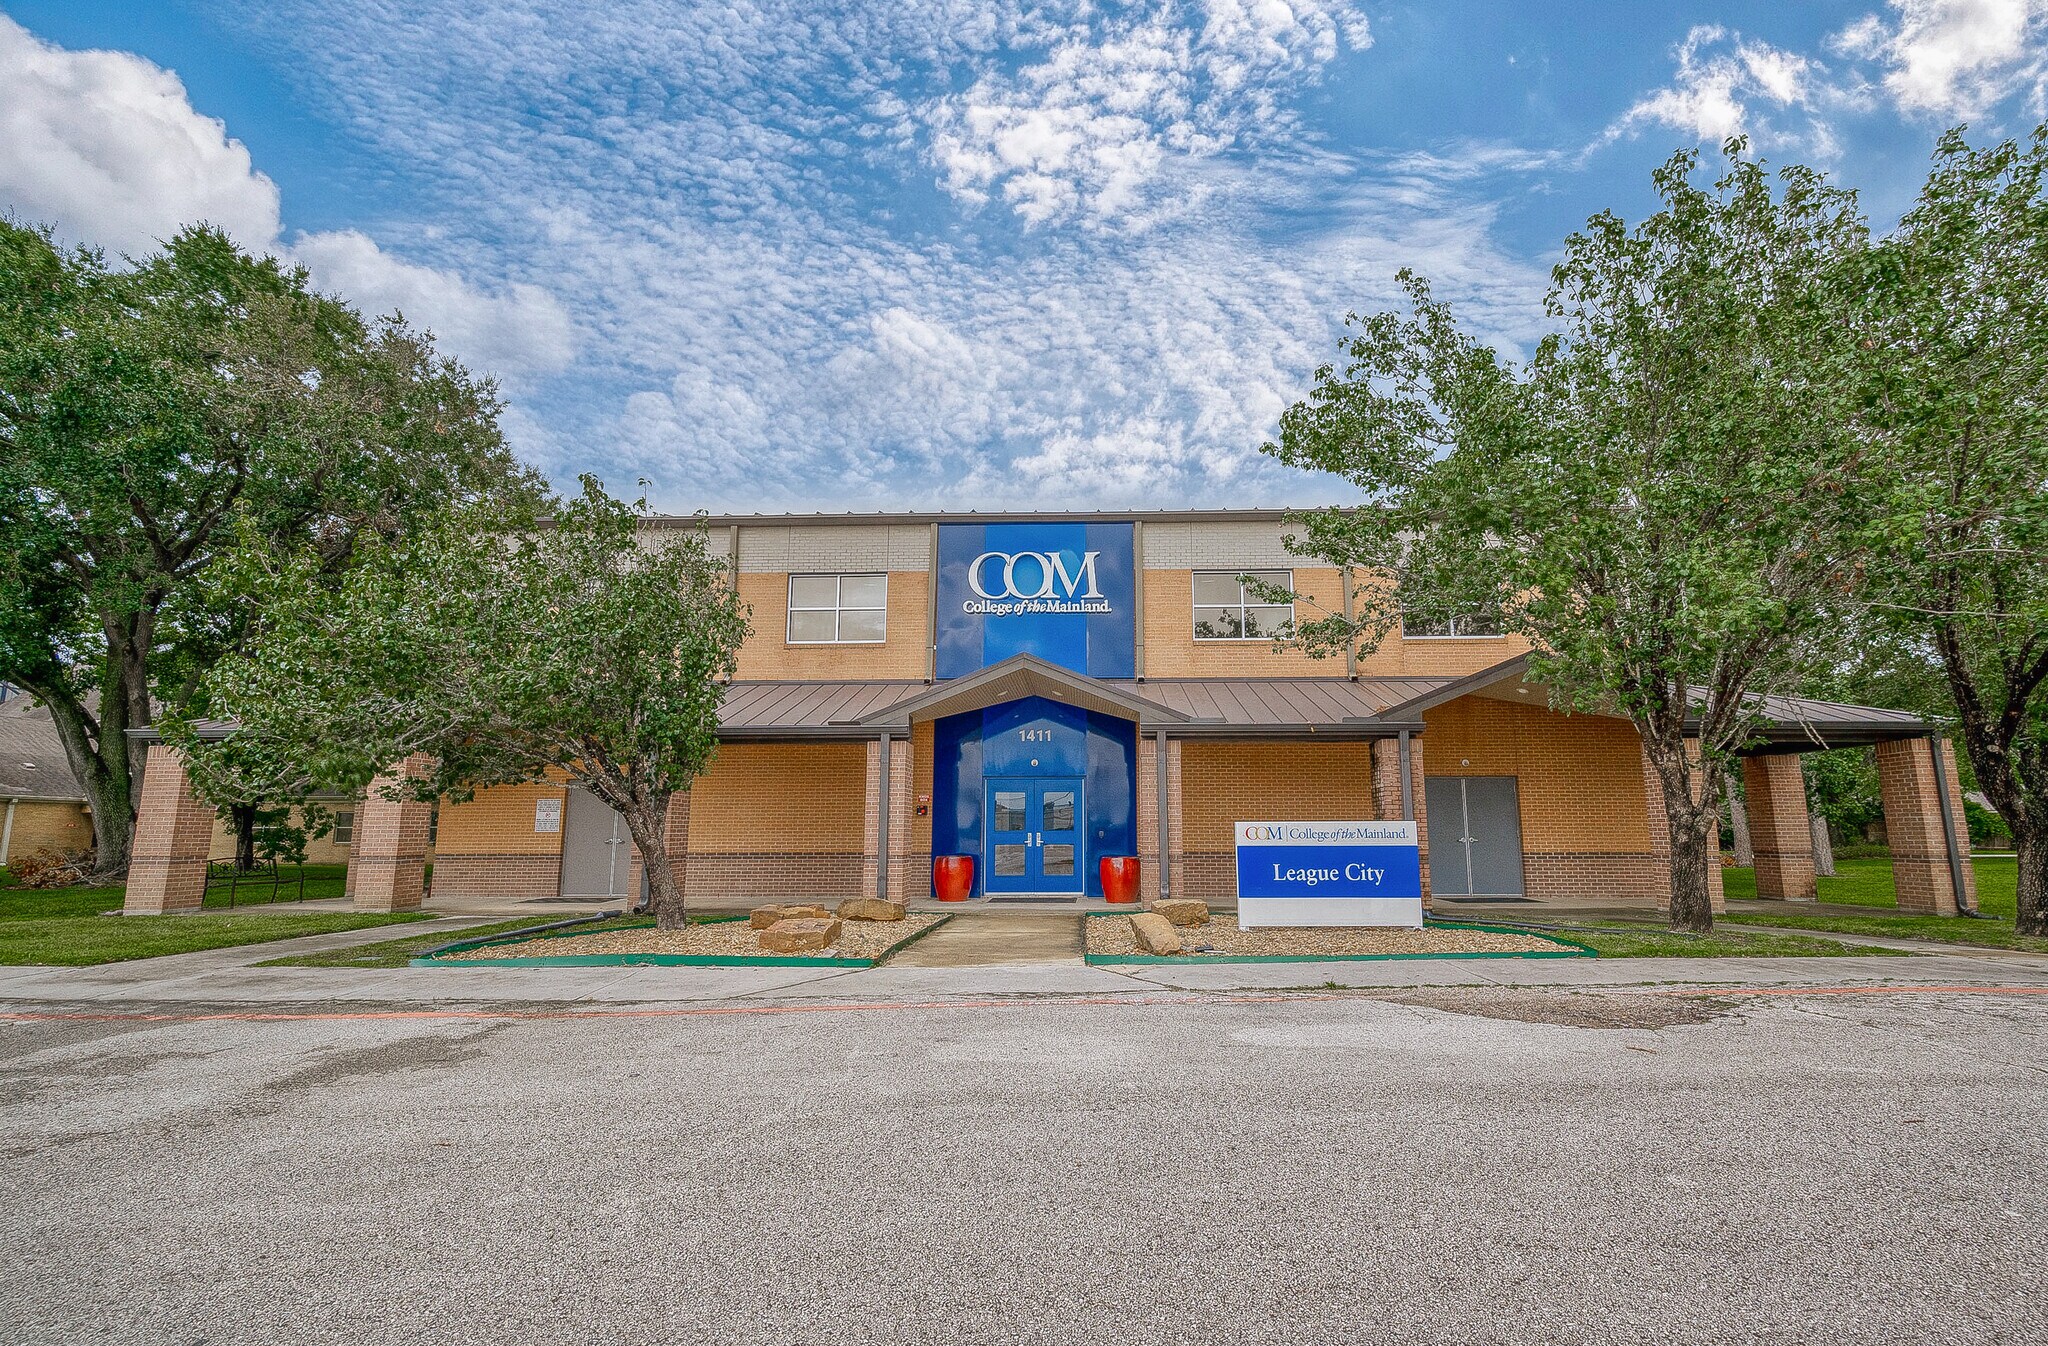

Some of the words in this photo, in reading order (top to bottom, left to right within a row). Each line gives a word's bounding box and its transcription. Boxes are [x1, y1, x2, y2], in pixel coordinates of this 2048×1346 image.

[968, 551, 1105, 599] COM
[962, 600, 1013, 617] College
[1013, 600, 1030, 616] of
[1027, 600, 1047, 613] the
[1019, 729, 1051, 742] 1411
[1245, 826, 1283, 840] COM
[1289, 827, 1330, 843] College
[1330, 827, 1343, 842] of
[1341, 827, 1357, 840] the
[1273, 863, 1340, 886] League
[1344, 863, 1385, 886] City
